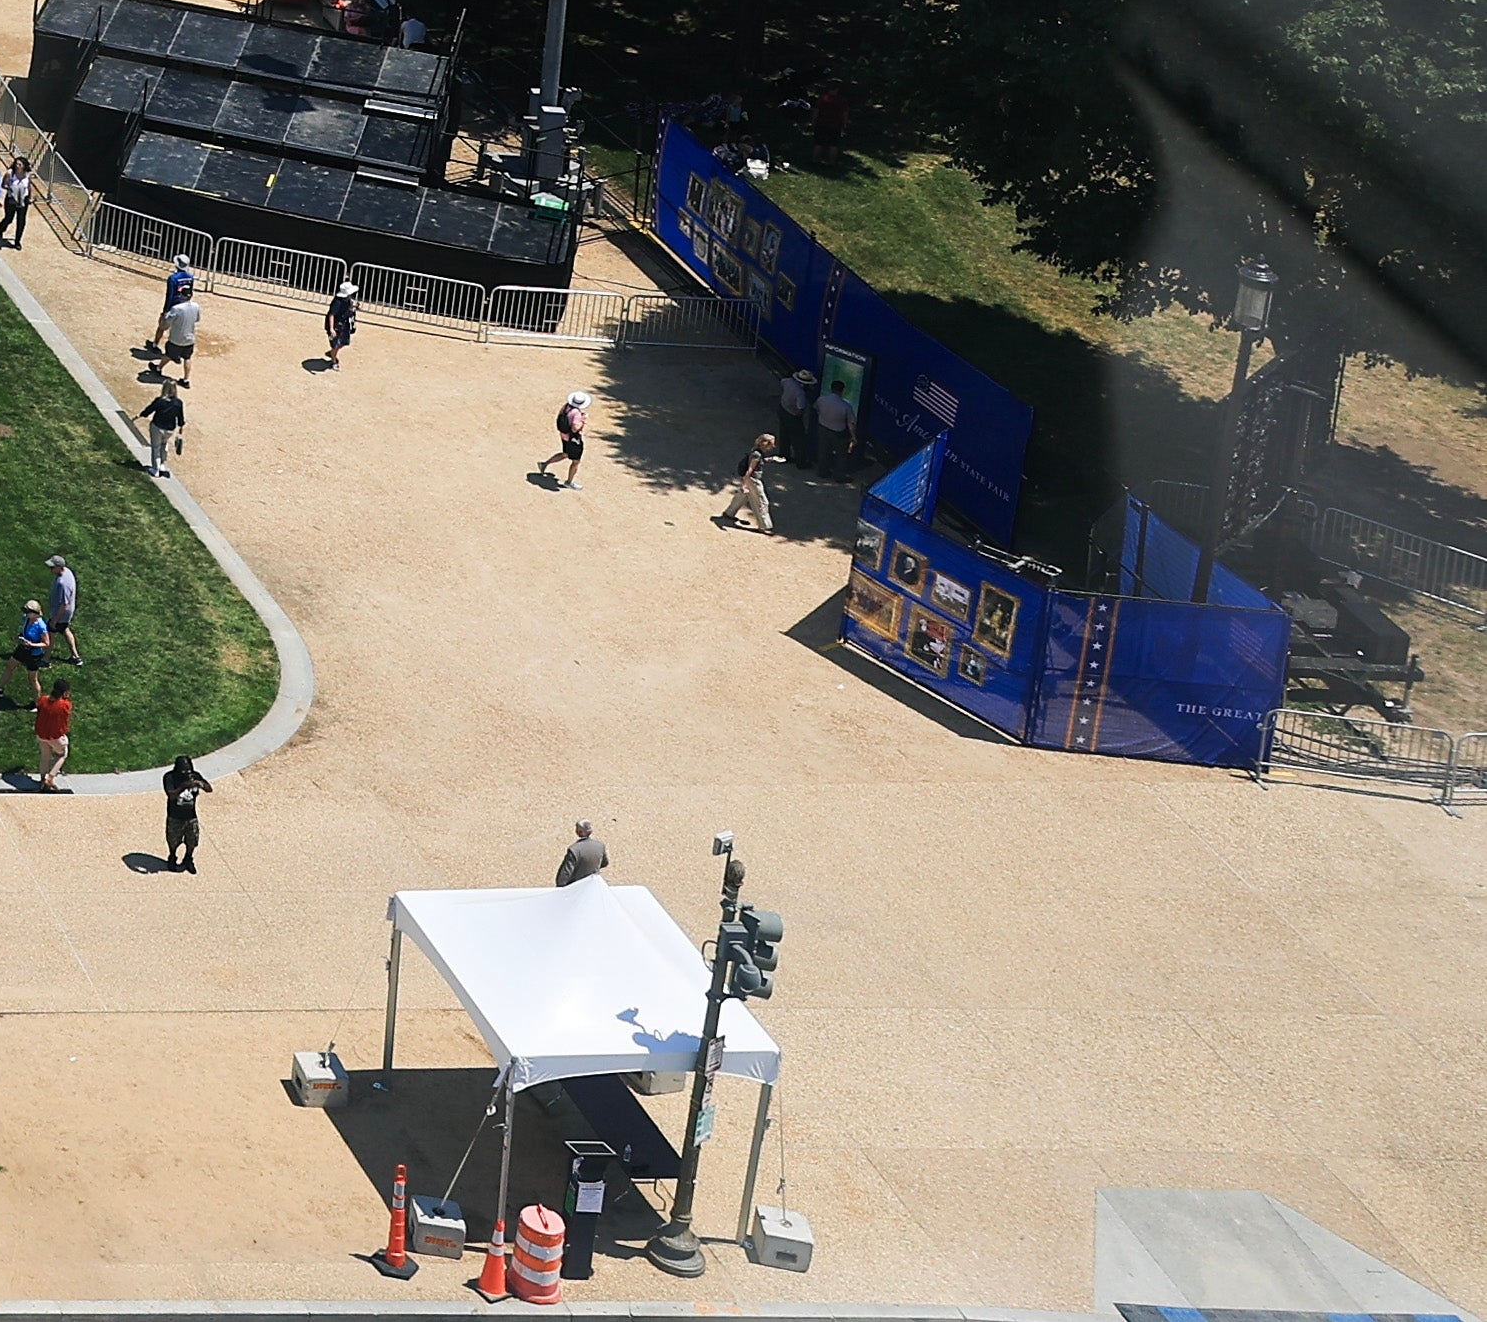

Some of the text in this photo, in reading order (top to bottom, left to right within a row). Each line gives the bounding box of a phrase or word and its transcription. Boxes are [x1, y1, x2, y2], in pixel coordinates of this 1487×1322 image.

[824, 344, 866, 362] INFORMATION
[960, 458, 987, 485] STATE
[987, 481, 1011, 503] FAIR
[1176, 702, 1265, 723] THE GREAT
